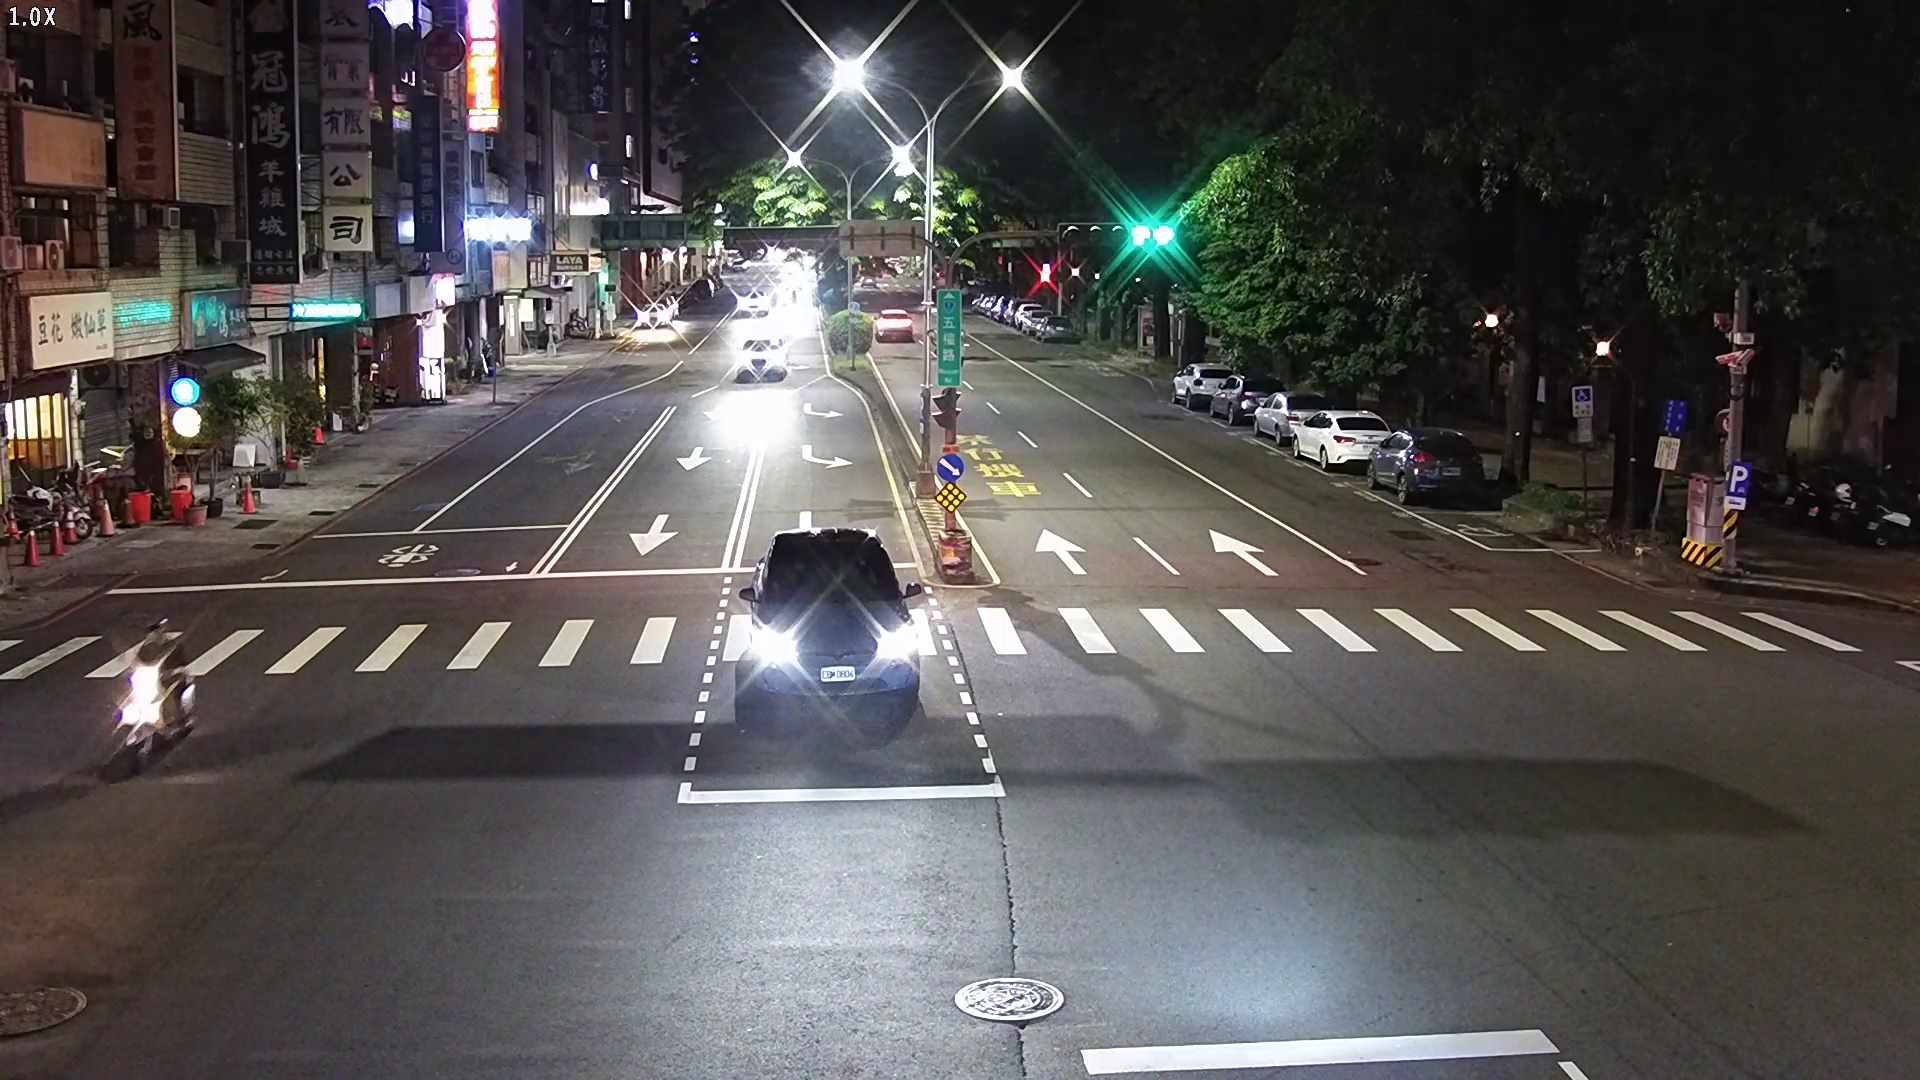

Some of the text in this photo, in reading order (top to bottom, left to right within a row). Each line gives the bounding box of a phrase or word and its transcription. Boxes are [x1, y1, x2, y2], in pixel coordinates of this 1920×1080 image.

[556, 255, 584, 265] LAYA
[38, 312, 63, 346] 豆花
[1728, 464, 1749, 493] P
